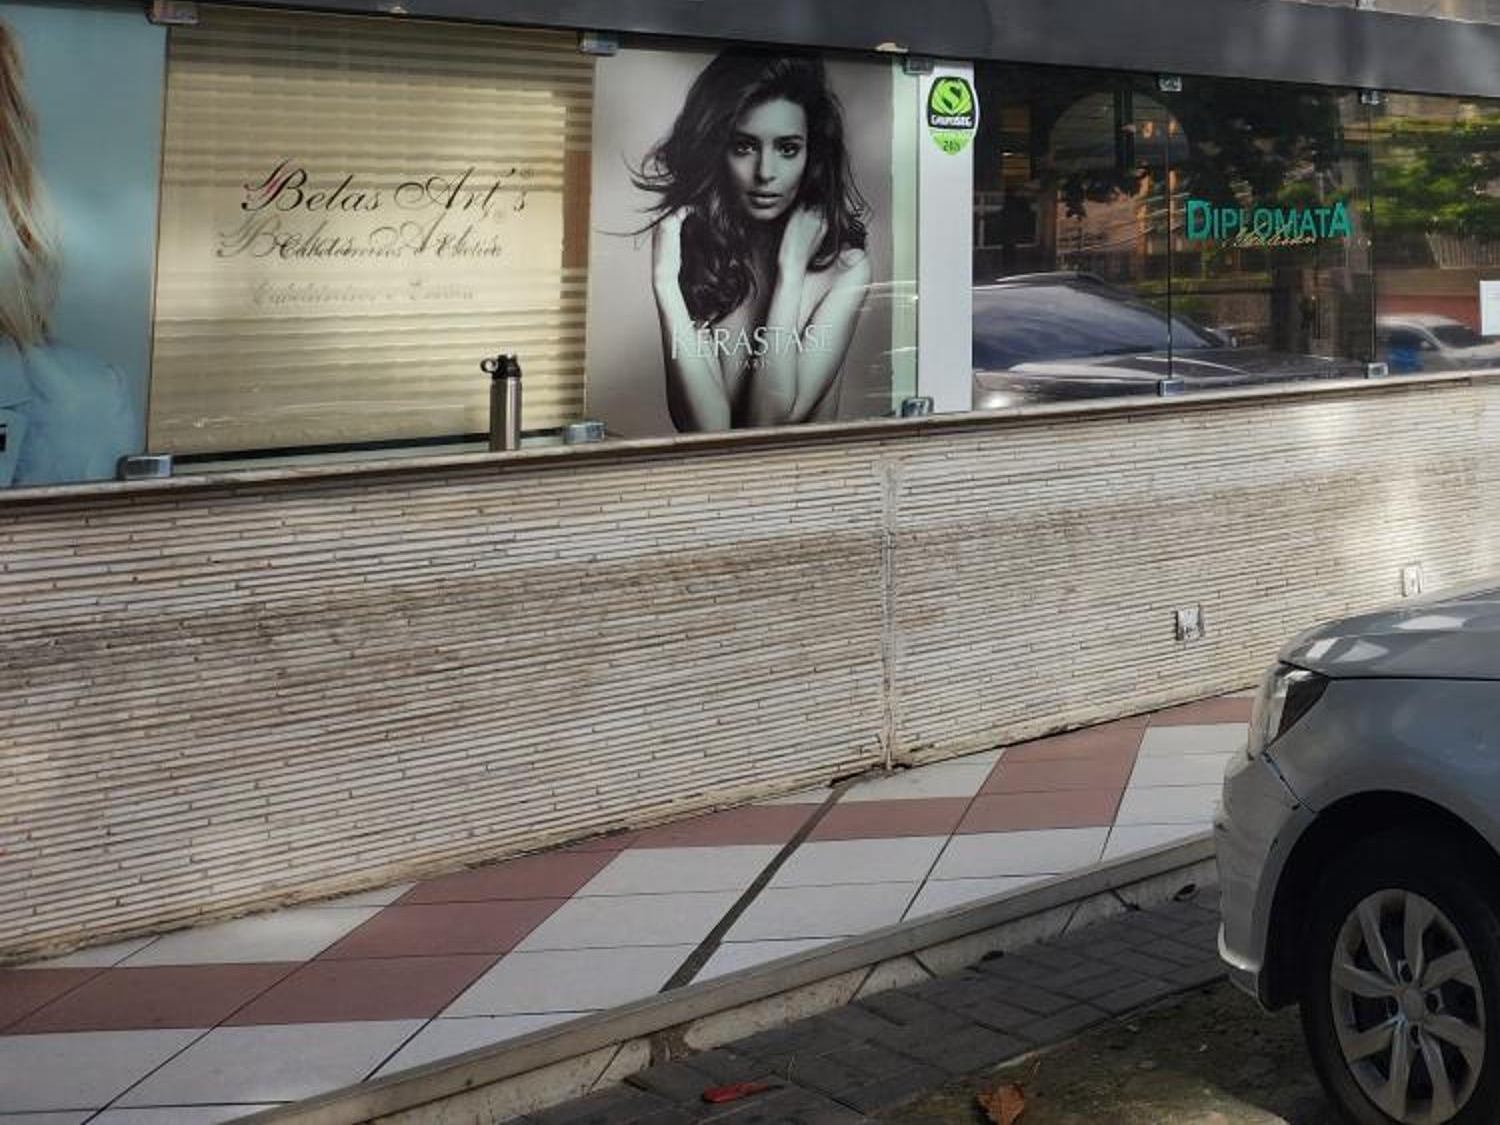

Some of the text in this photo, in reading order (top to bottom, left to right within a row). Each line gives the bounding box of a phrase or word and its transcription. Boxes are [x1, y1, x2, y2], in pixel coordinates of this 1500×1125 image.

[241, 159, 381, 213] Belas
[1186, 199, 1354, 242] DIPLOMATA
[671, 320, 833, 360] KÉRASTASE
